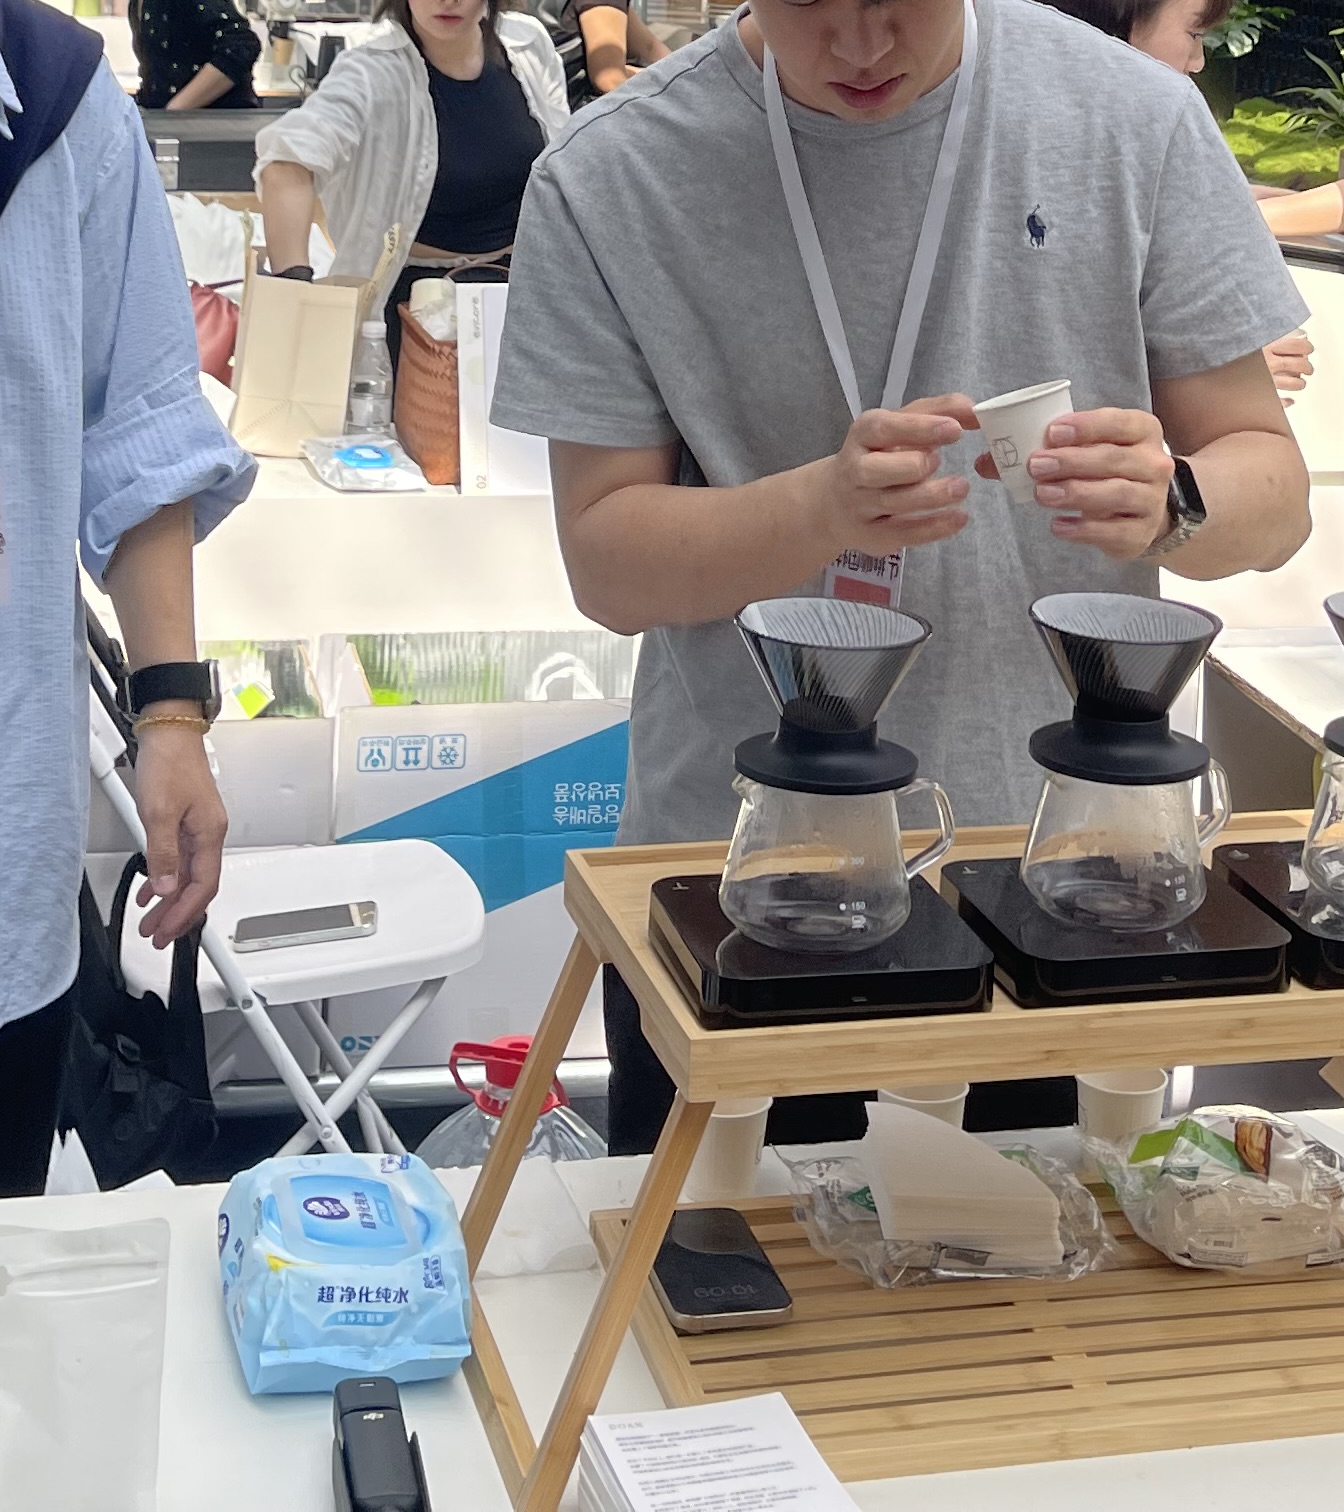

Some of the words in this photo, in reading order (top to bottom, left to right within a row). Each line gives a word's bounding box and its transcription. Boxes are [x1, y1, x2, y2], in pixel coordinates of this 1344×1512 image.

[476, 474, 488, 489] 02
[553, 781, 622, 804] 보냉상품
[552, 804, 620, 826] 당일배송
